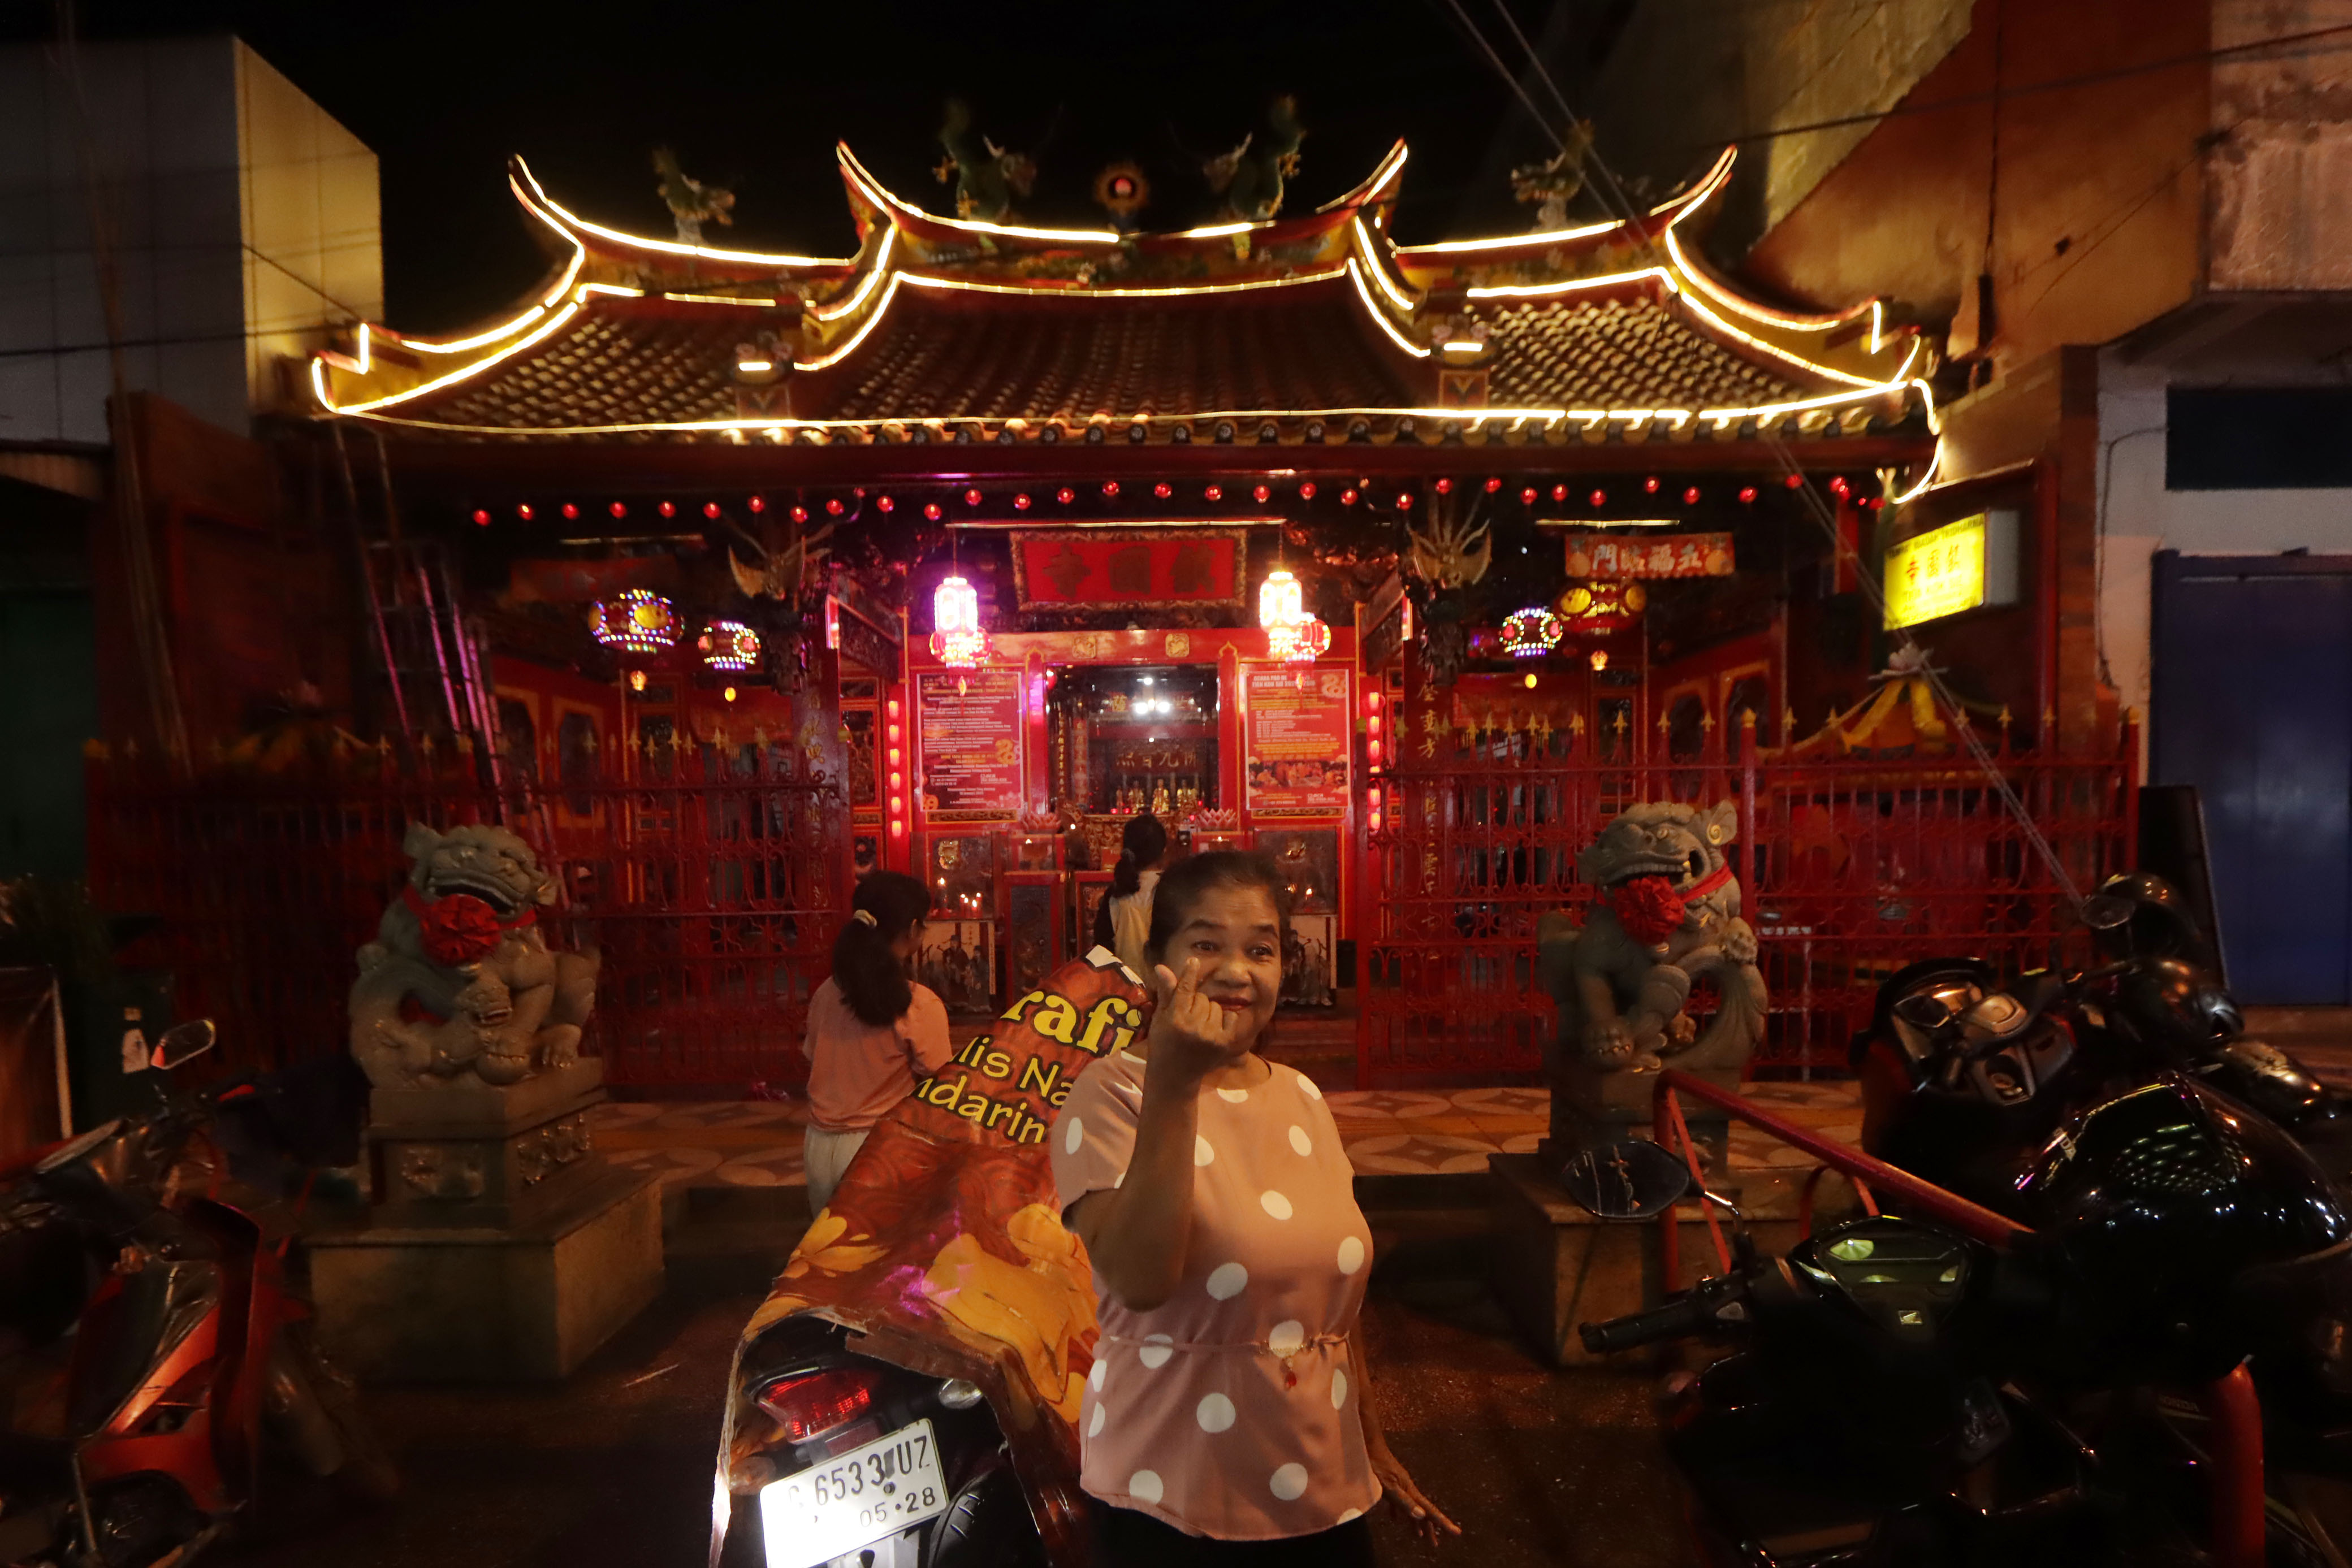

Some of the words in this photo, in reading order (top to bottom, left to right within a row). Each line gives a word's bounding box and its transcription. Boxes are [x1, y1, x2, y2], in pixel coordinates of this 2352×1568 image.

[950, 1036, 1011, 1078] lis
[815, 1453, 887, 1506] 6533
[896, 1435, 931, 1475] UZ
